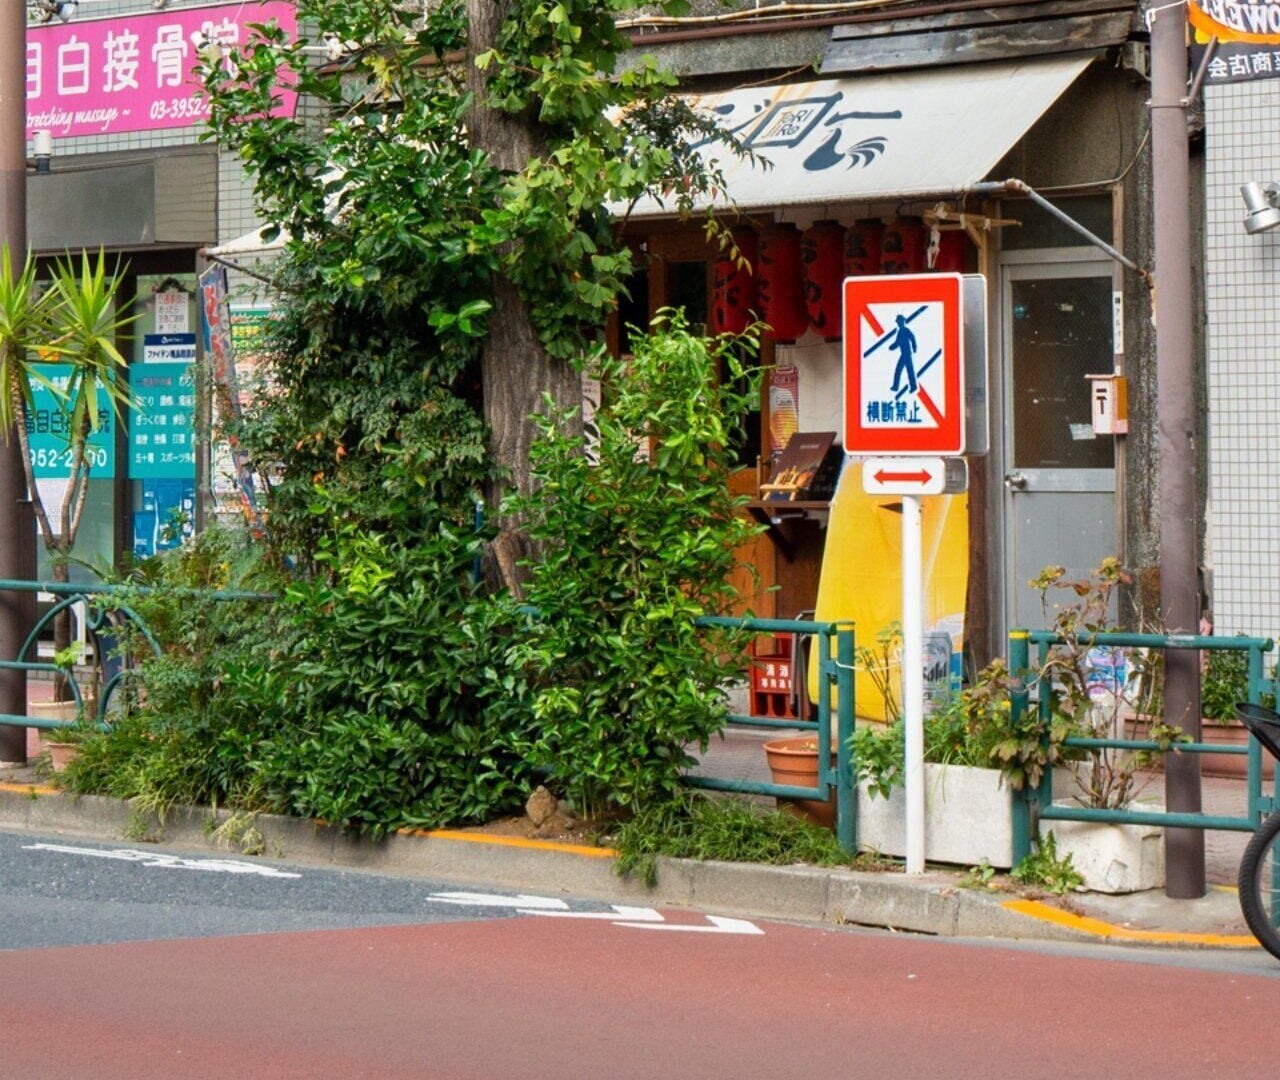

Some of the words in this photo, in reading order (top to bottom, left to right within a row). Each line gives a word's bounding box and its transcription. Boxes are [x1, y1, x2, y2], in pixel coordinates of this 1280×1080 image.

[26, 106, 72, 133] tretching
[75, 107, 119, 131] massage
[150, 96, 215, 121] 03-3952-2
[867, 401, 922, 423] 横断禁止
